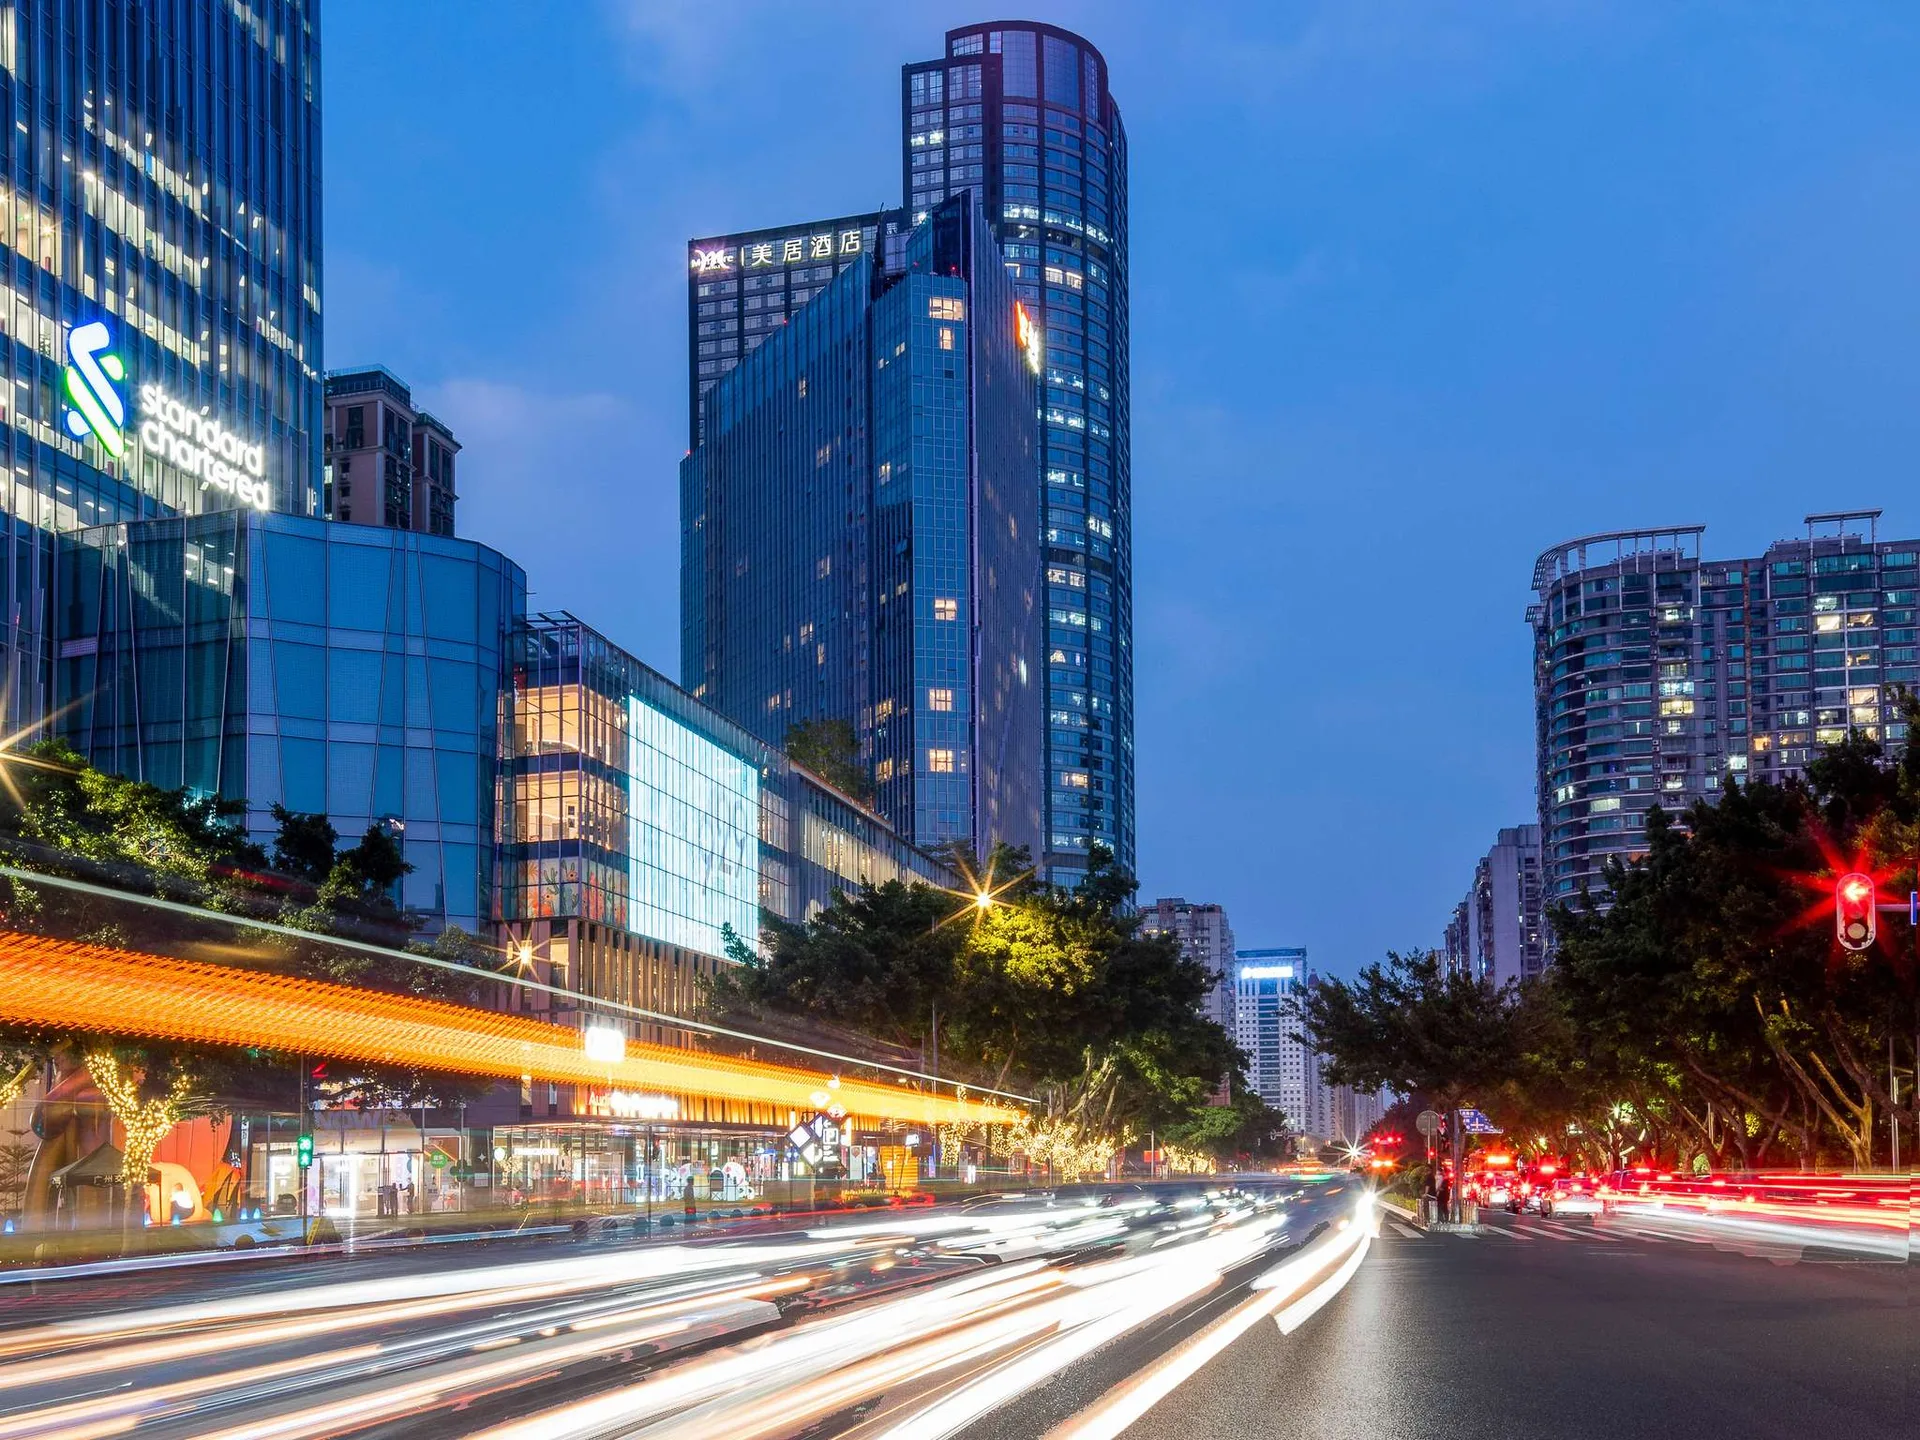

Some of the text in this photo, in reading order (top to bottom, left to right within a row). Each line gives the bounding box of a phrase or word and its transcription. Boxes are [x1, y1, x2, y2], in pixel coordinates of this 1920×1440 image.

[751, 231, 861, 267] 美居酒店
[140, 420, 269, 511] chartered
[141, 383, 263, 477] standard
